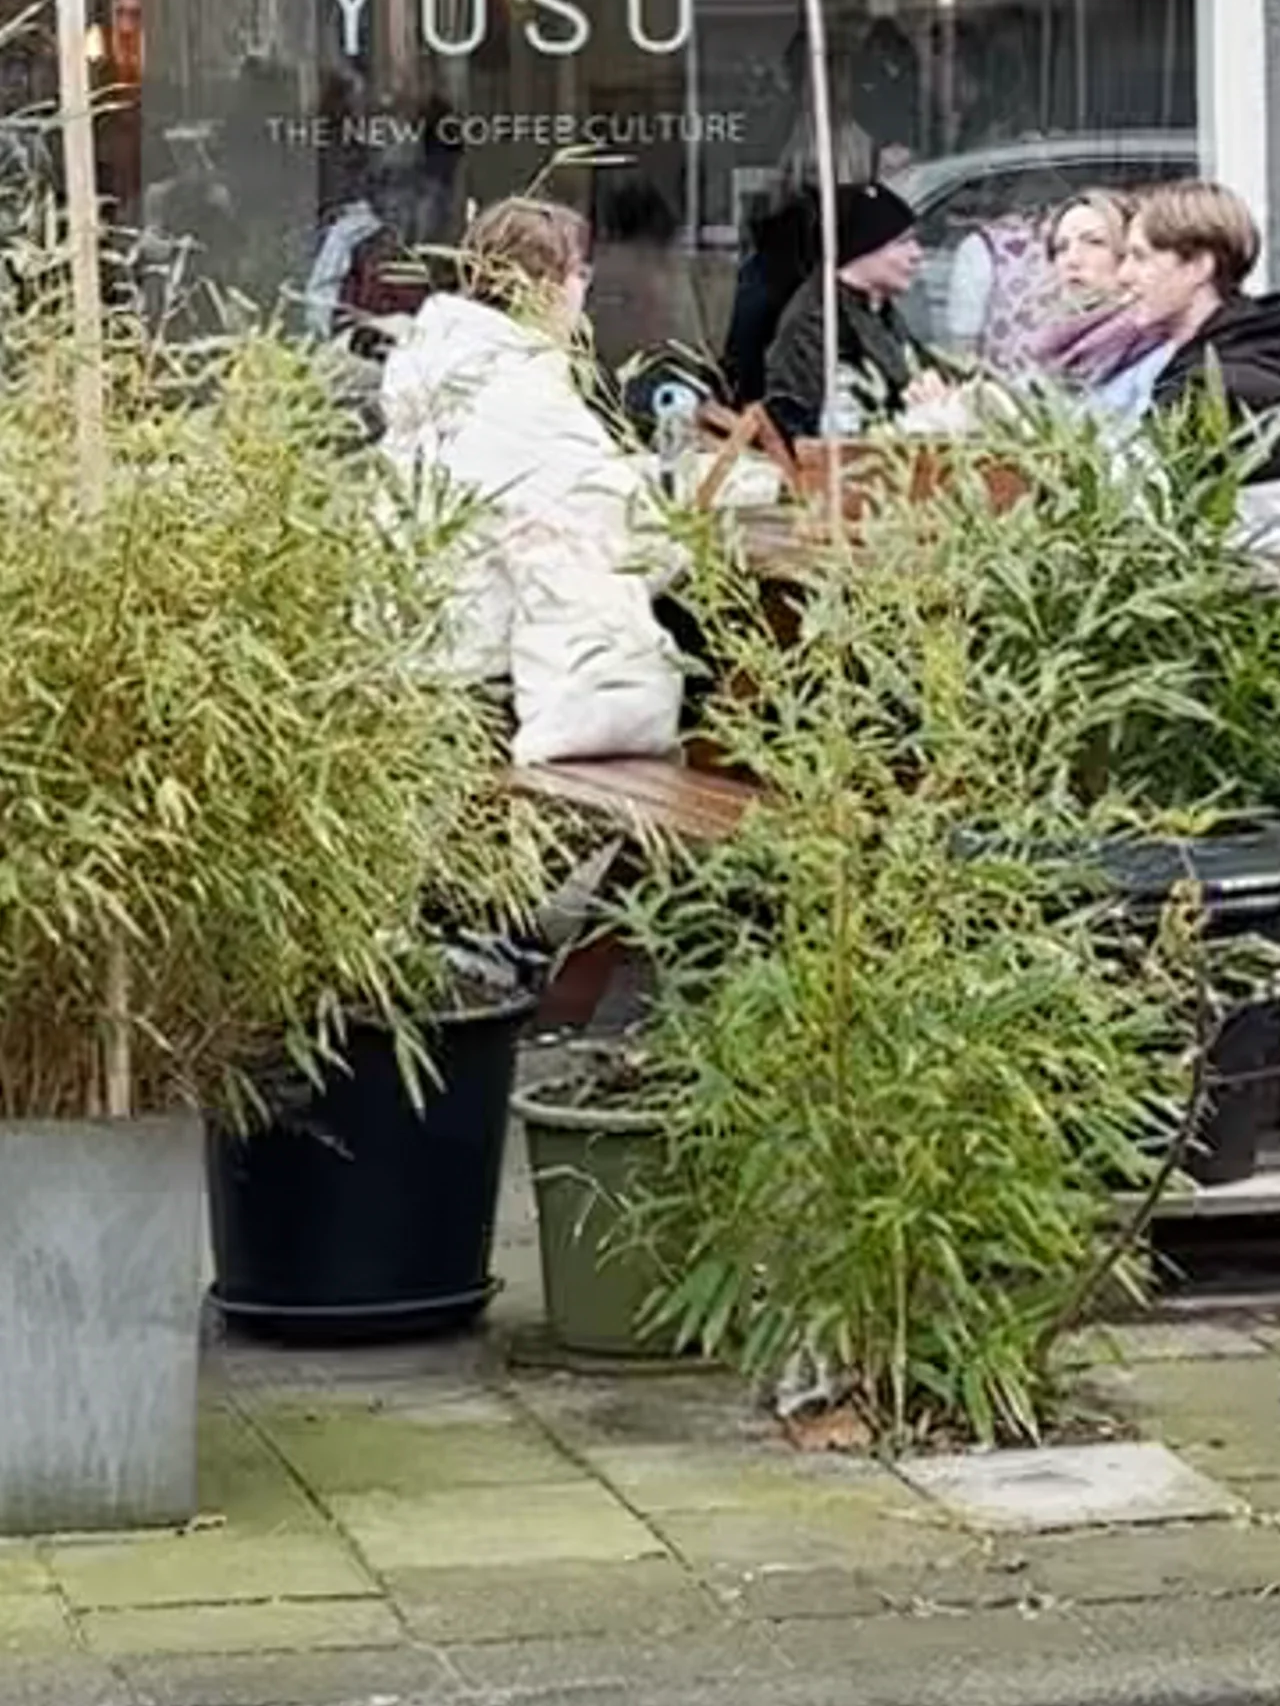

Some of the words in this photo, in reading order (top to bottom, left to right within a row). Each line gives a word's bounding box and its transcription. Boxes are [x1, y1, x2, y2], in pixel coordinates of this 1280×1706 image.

[266, 116, 329, 146] THE
[343, 116, 420, 146] NEW
[435, 114, 577, 146] COFFEE
[581, 112, 747, 145] CULTURE
